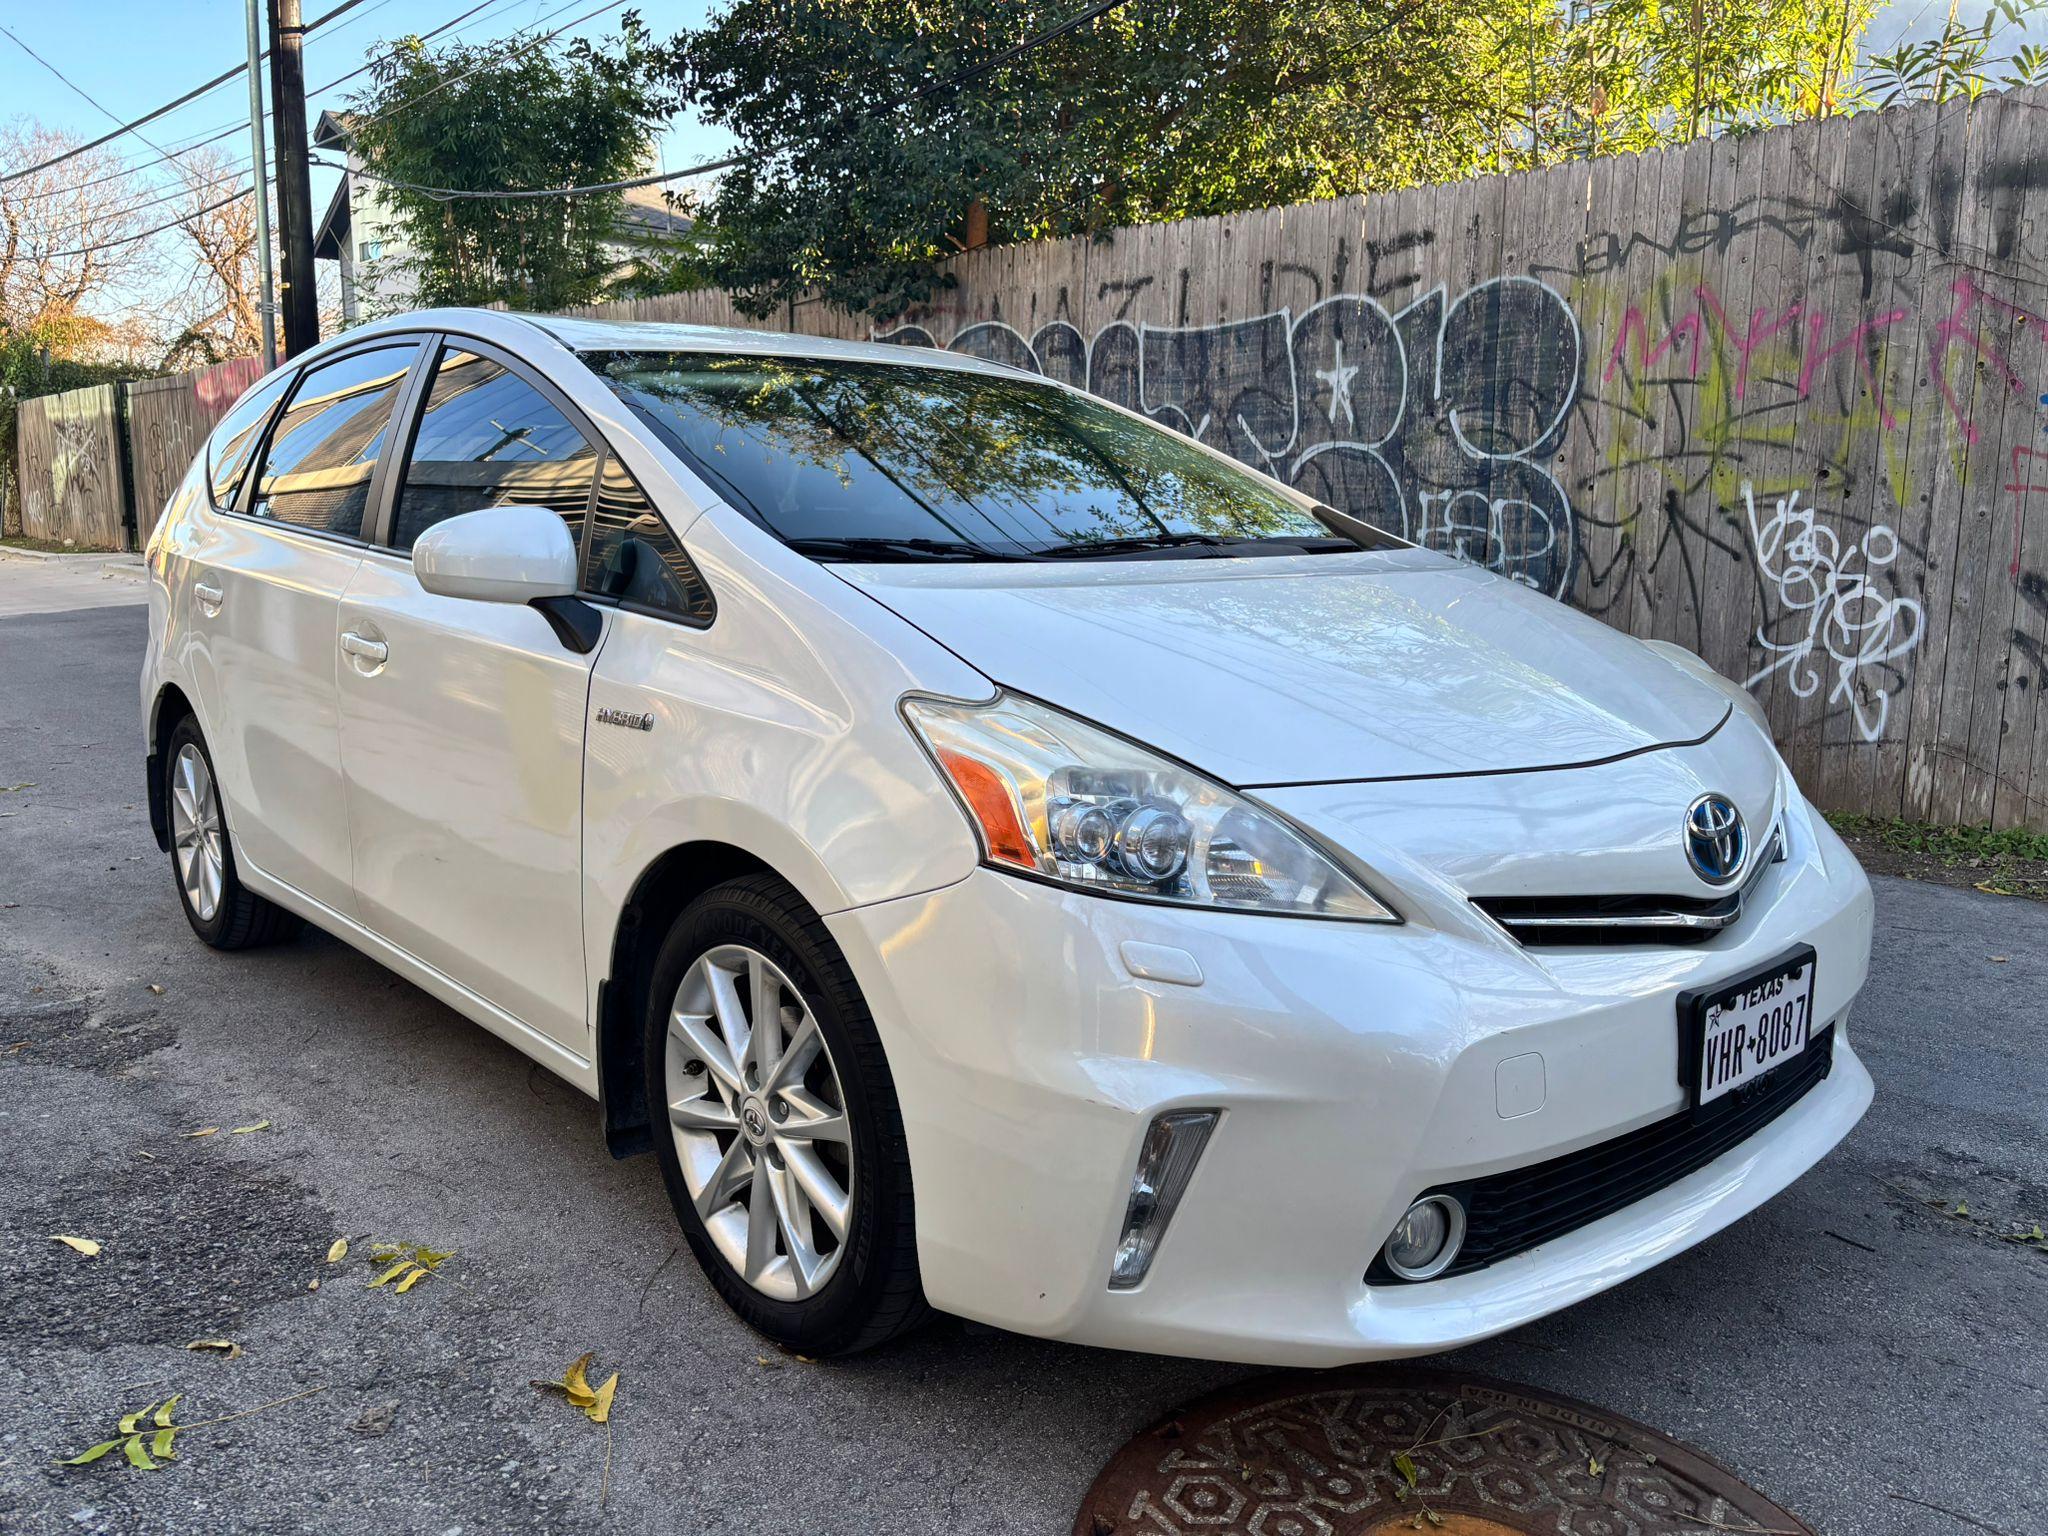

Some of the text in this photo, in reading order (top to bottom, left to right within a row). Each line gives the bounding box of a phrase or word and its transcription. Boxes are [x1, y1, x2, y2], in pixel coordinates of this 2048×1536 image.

[1742, 978, 1784, 1011] TEXAS
[1467, 1387, 1614, 1434] MADE IN USA
